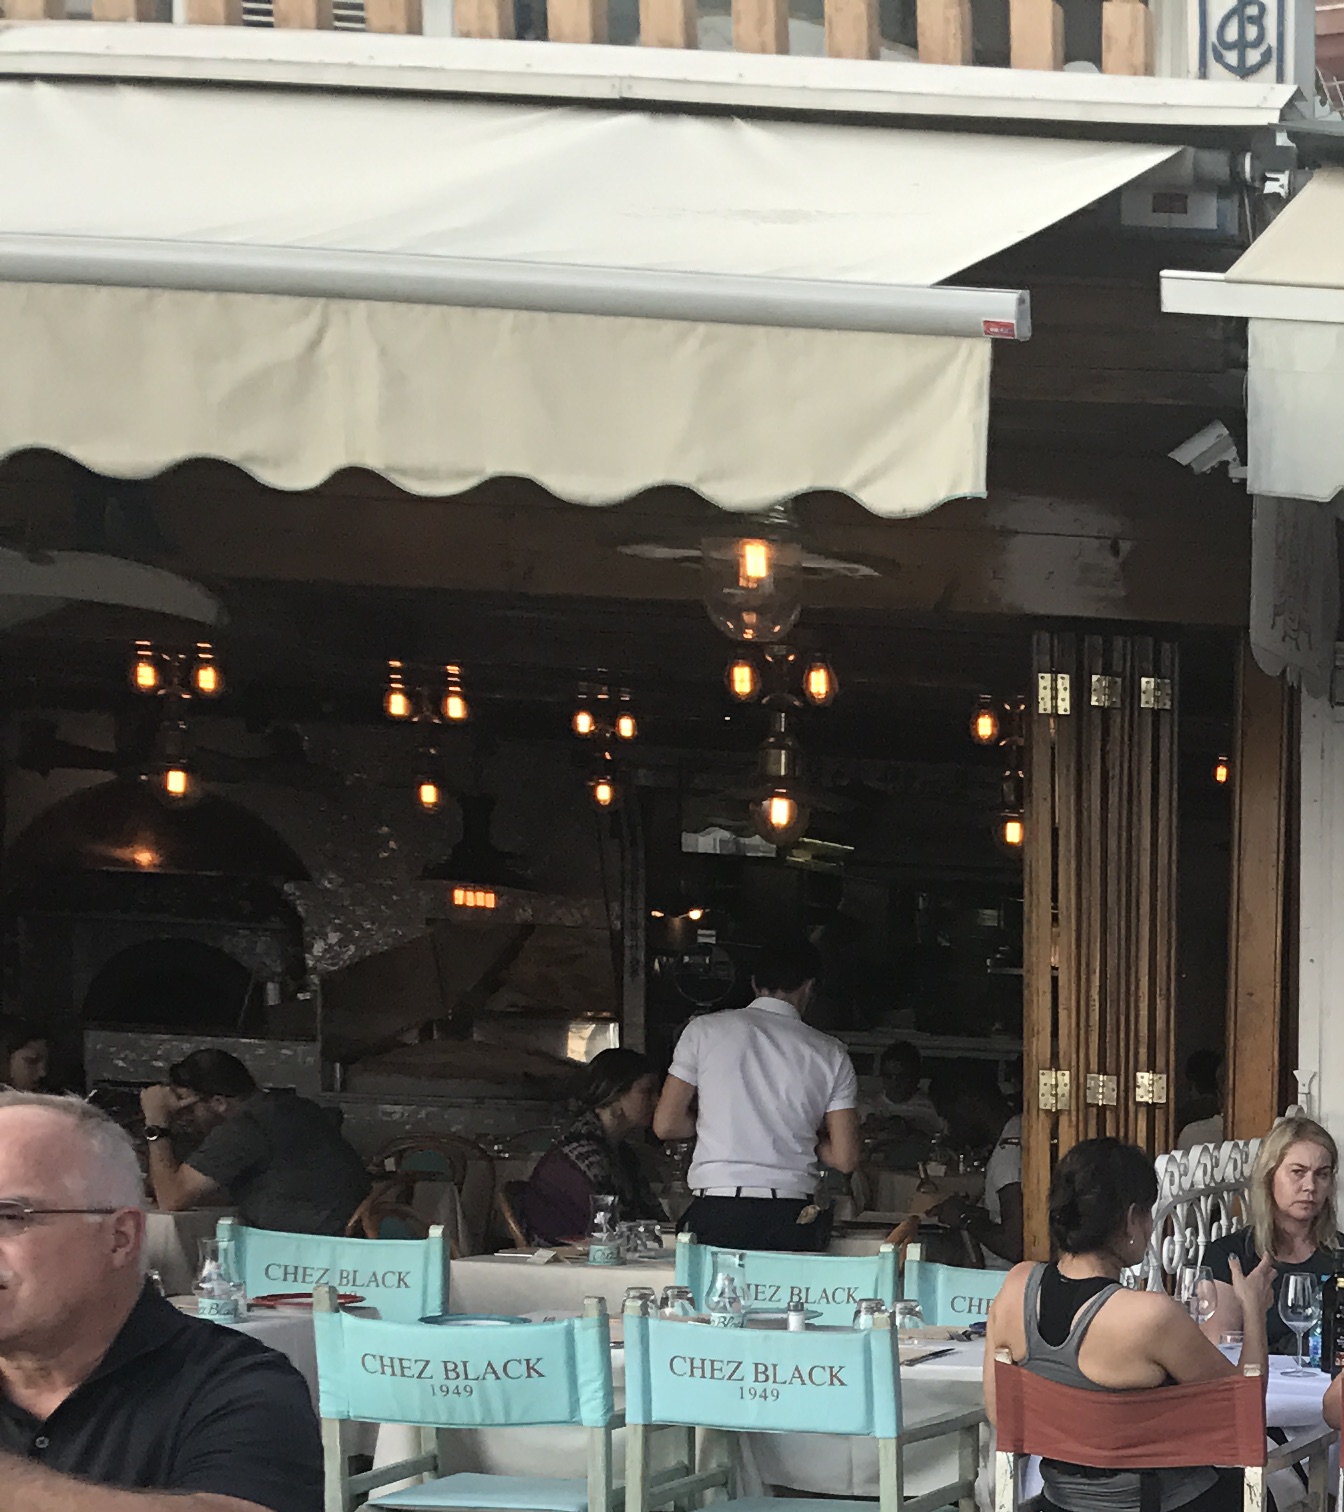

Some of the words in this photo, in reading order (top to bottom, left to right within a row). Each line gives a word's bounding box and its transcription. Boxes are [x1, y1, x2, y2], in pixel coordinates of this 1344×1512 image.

[264, 1263, 331, 1286] CHEZ
[338, 1268, 411, 1289] BLACK
[789, 1285, 860, 1305] BLACK
[360, 1352, 434, 1381] CHEZ
[442, 1357, 546, 1382] BLACK
[668, 1354, 745, 1383] CHEZ
[752, 1361, 848, 1388] BLACK
[430, 1383, 474, 1399] 1949
[738, 1386, 780, 1402] 1949
